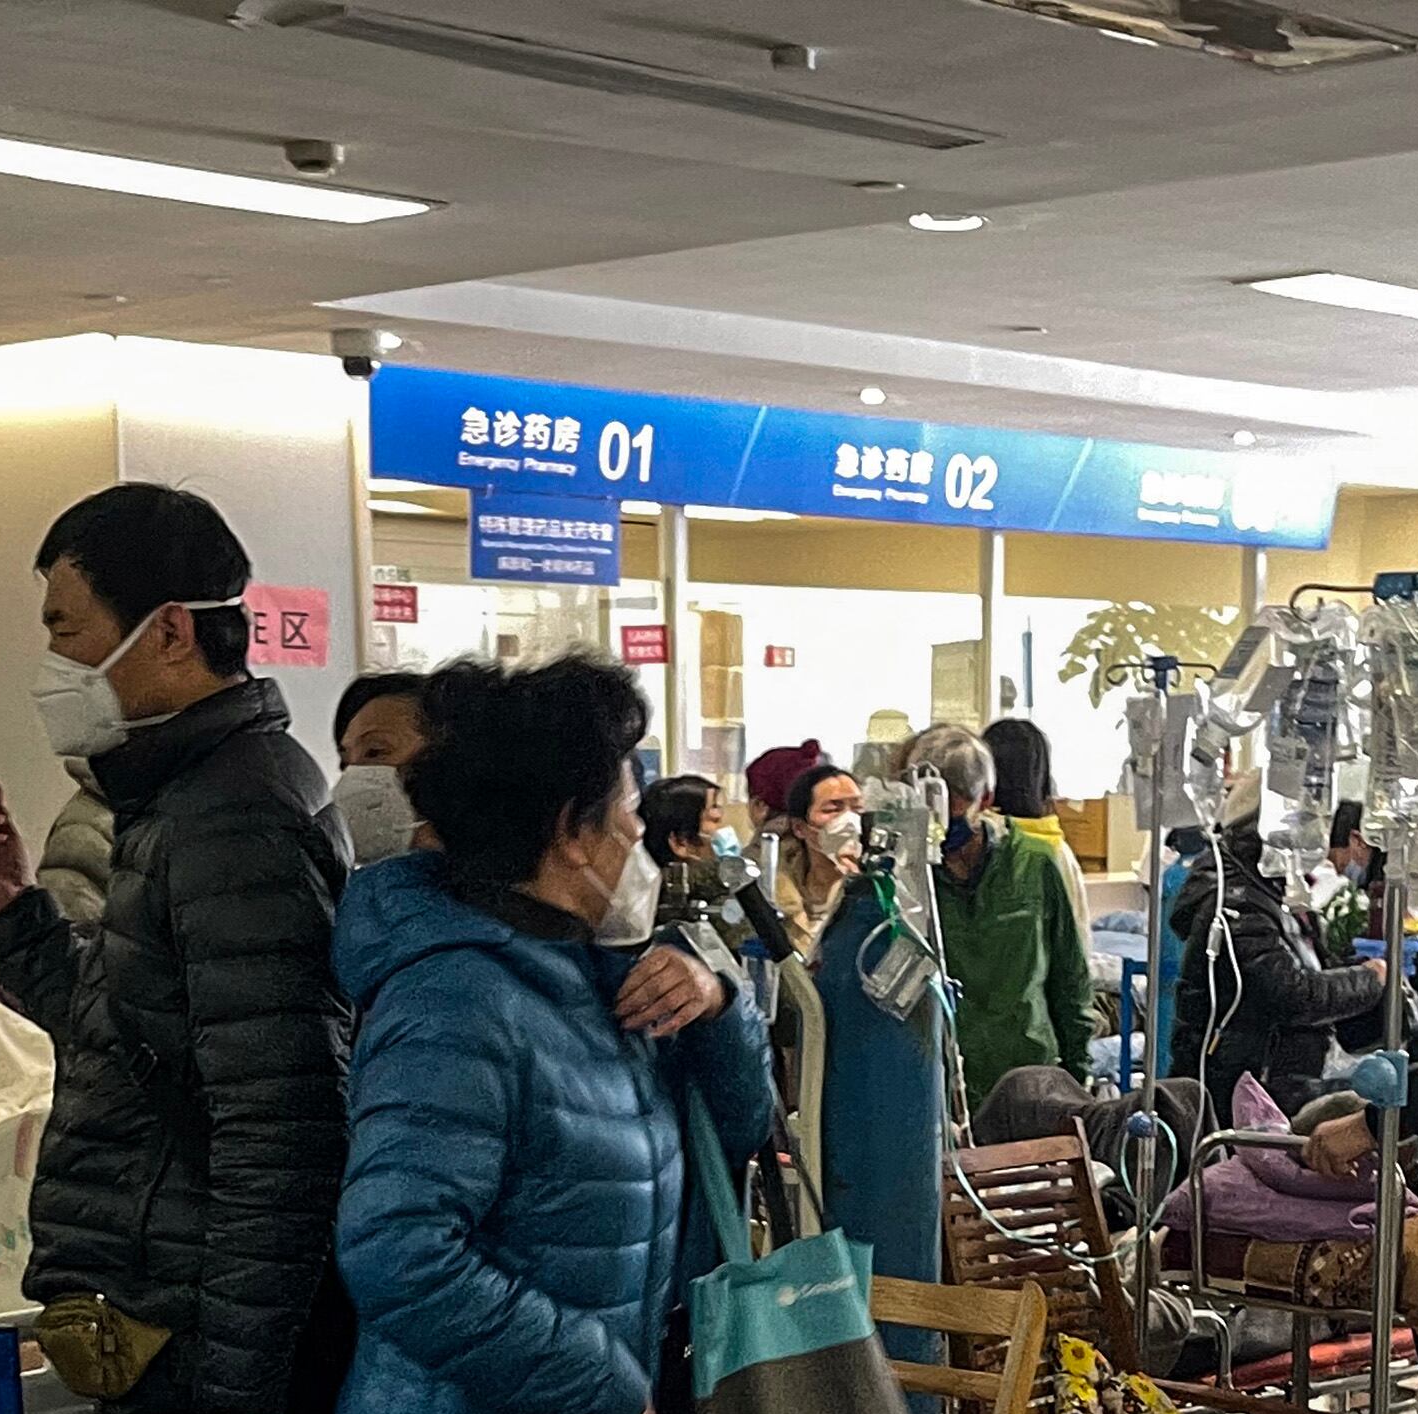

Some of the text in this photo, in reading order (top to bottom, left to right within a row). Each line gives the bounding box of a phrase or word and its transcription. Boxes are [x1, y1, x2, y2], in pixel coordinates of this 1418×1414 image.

[460, 406, 654, 482] 急诊药房 01
[945, 453, 999, 511] 02
